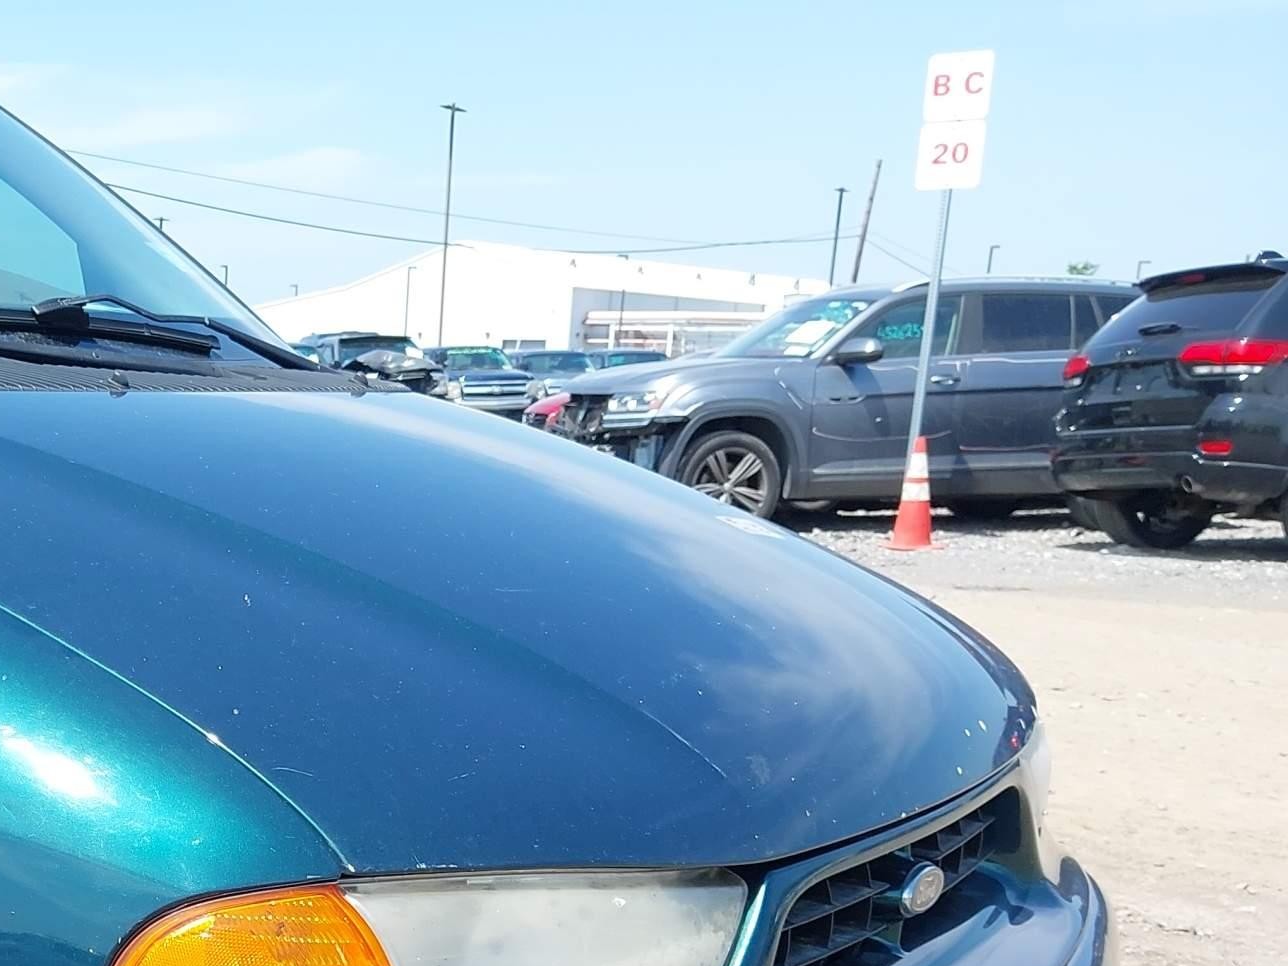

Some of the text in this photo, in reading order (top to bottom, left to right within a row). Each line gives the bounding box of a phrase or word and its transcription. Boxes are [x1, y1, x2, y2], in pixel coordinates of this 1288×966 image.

[933, 71, 985, 97] B C
[931, 141, 969, 165] 20
